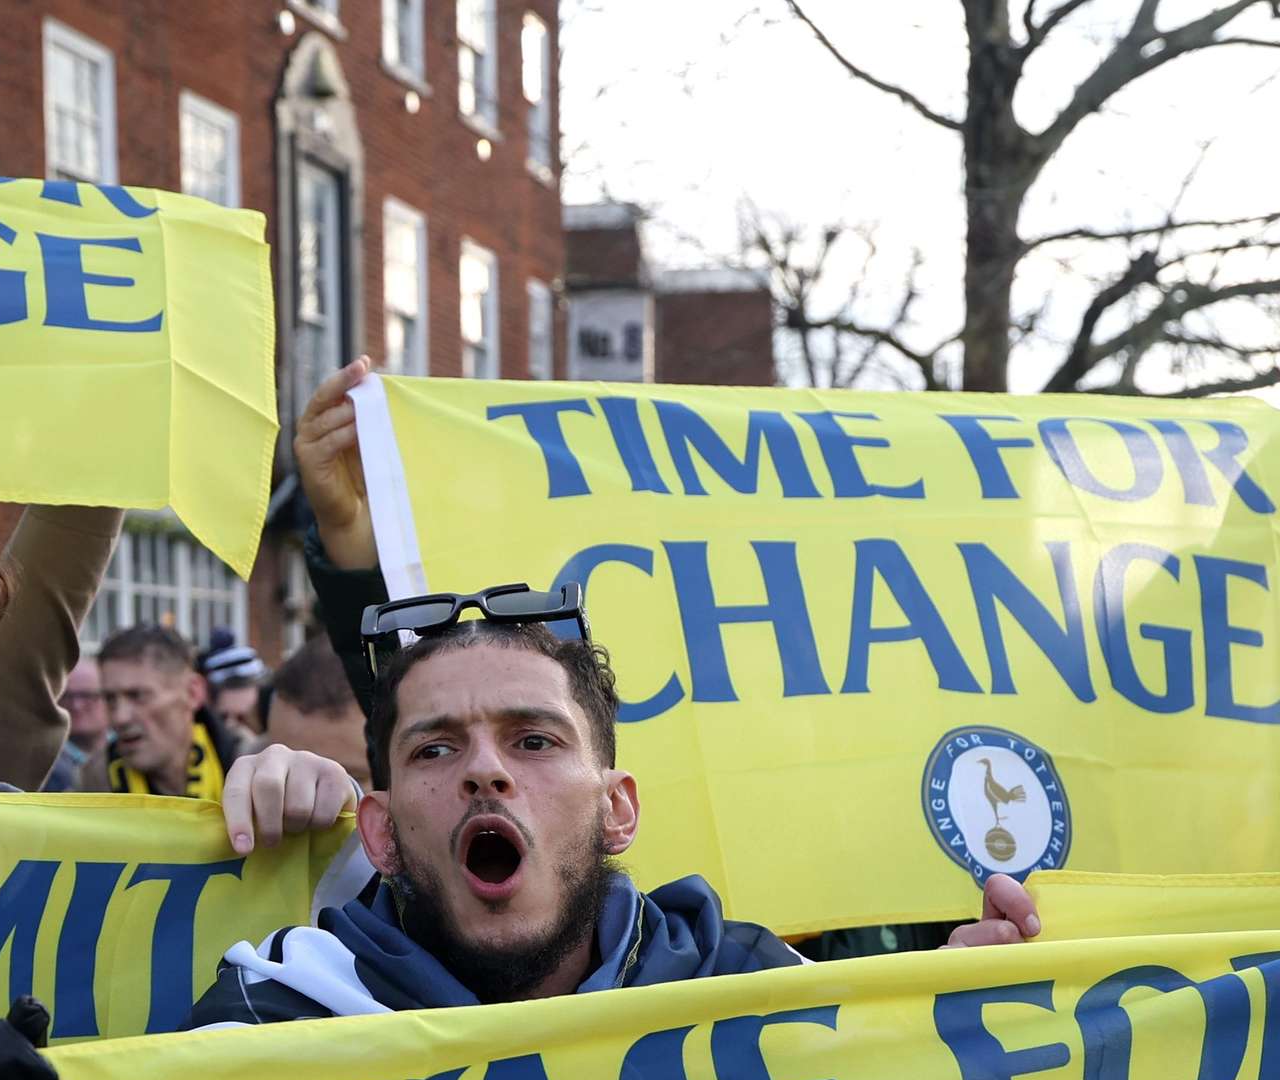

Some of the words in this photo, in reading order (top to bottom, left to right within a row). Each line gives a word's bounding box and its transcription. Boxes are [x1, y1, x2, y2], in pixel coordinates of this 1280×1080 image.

[488, 396, 926, 498] TIME
[939, 414, 1276, 514] FOR
[945, 733, 984, 758] FOR
